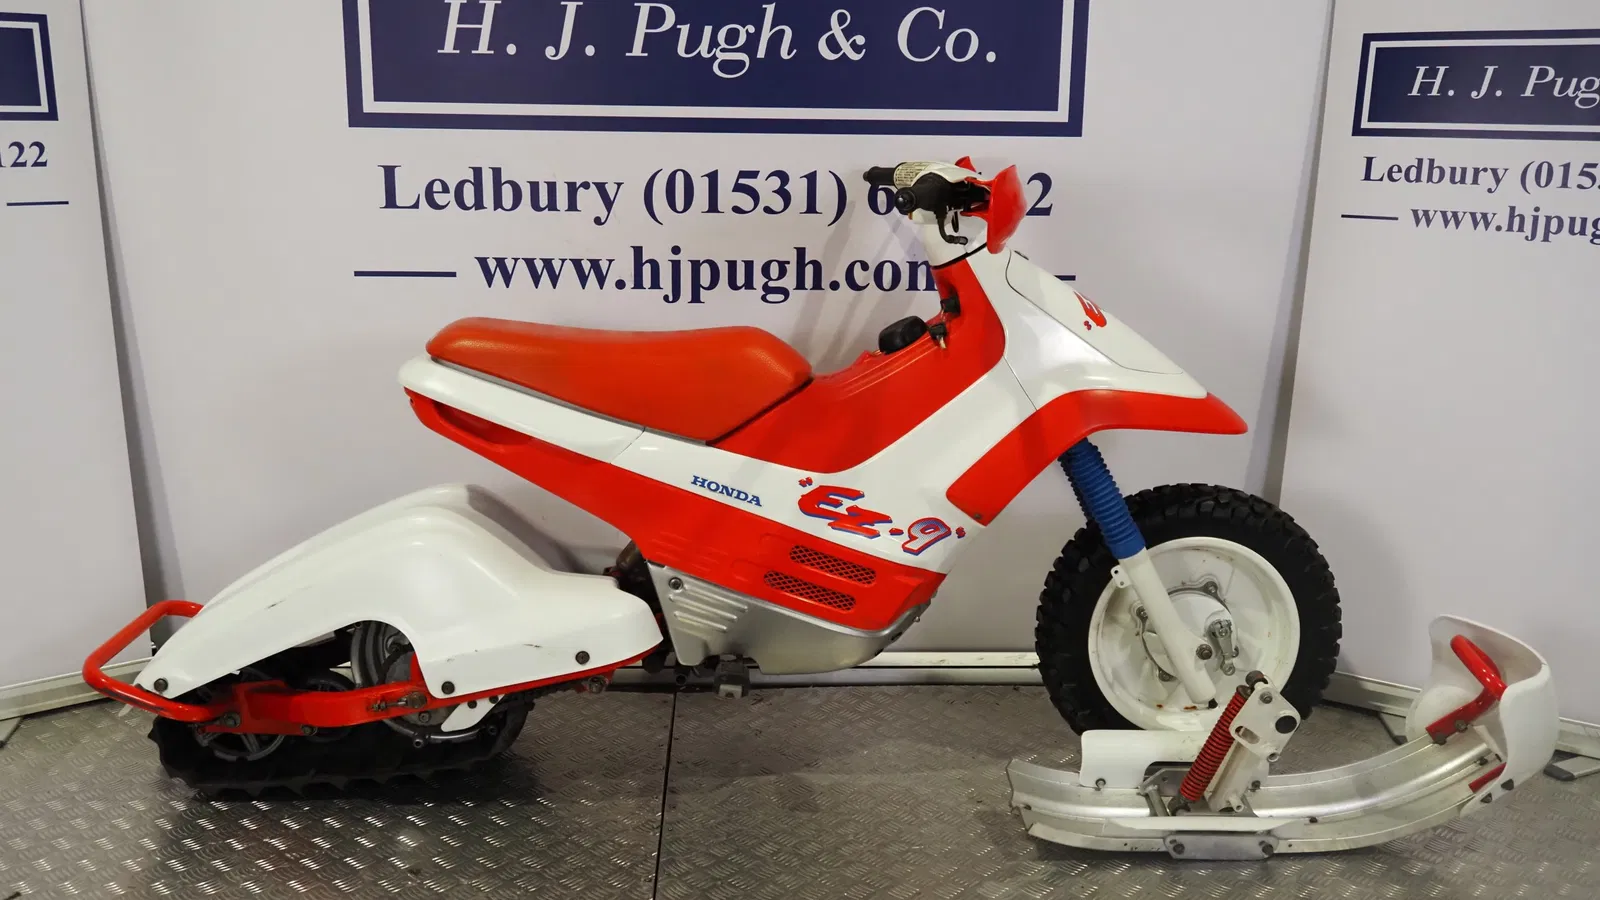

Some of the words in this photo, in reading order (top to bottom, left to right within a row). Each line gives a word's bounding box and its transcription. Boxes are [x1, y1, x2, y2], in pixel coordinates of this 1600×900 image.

[438, 0, 517, 55] H.
[545, 2, 595, 60] J.
[626, 3, 797, 79] Pugh
[818, 9, 867, 60] &
[897, 7, 997, 63] Co.
[1407, 65, 1455, 97] H.
[1470, 65, 1503, 99] J.
[1361, 156, 1509, 194] Ledbury
[378, 164, 624, 227] Ledbury
[643, 168, 847, 227] (01531)
[690, 475, 763, 507] HONDA
